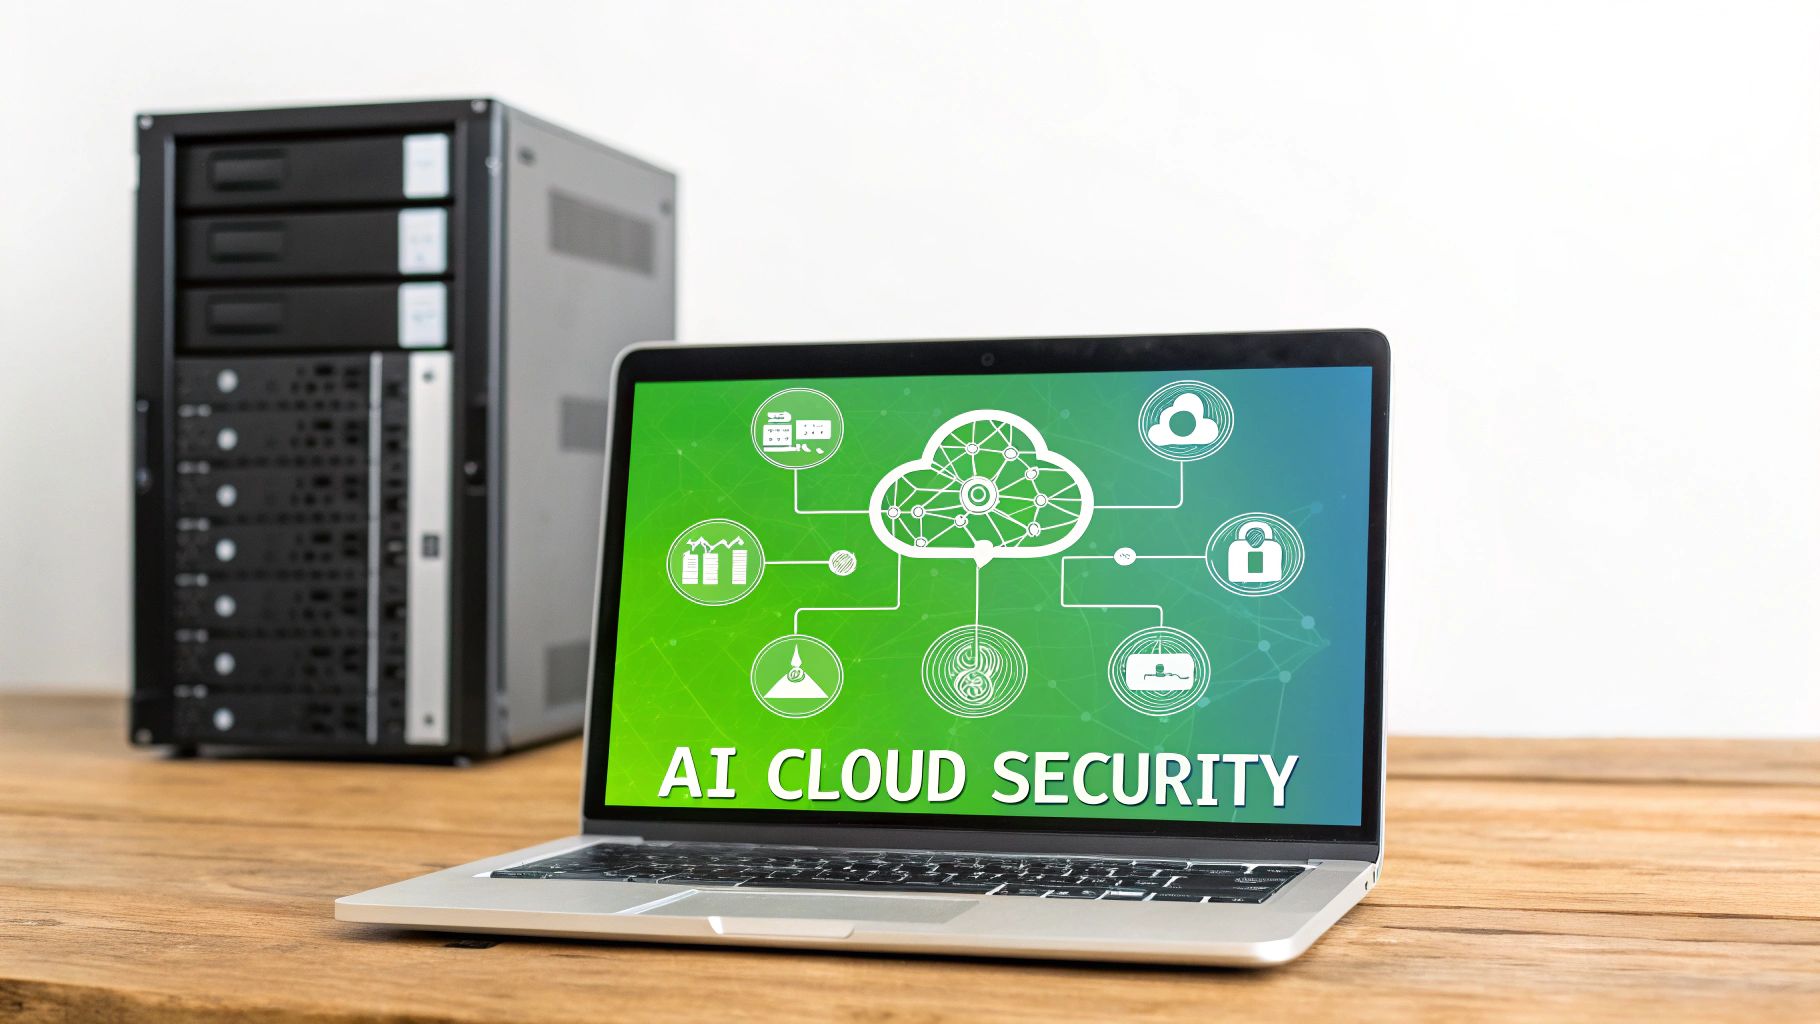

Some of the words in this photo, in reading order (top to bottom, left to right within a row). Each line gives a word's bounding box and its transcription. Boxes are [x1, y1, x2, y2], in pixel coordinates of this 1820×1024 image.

[658, 746, 737, 799] AI
[768, 748, 966, 802] CLOUD
[991, 750, 1299, 807] SECURITY
